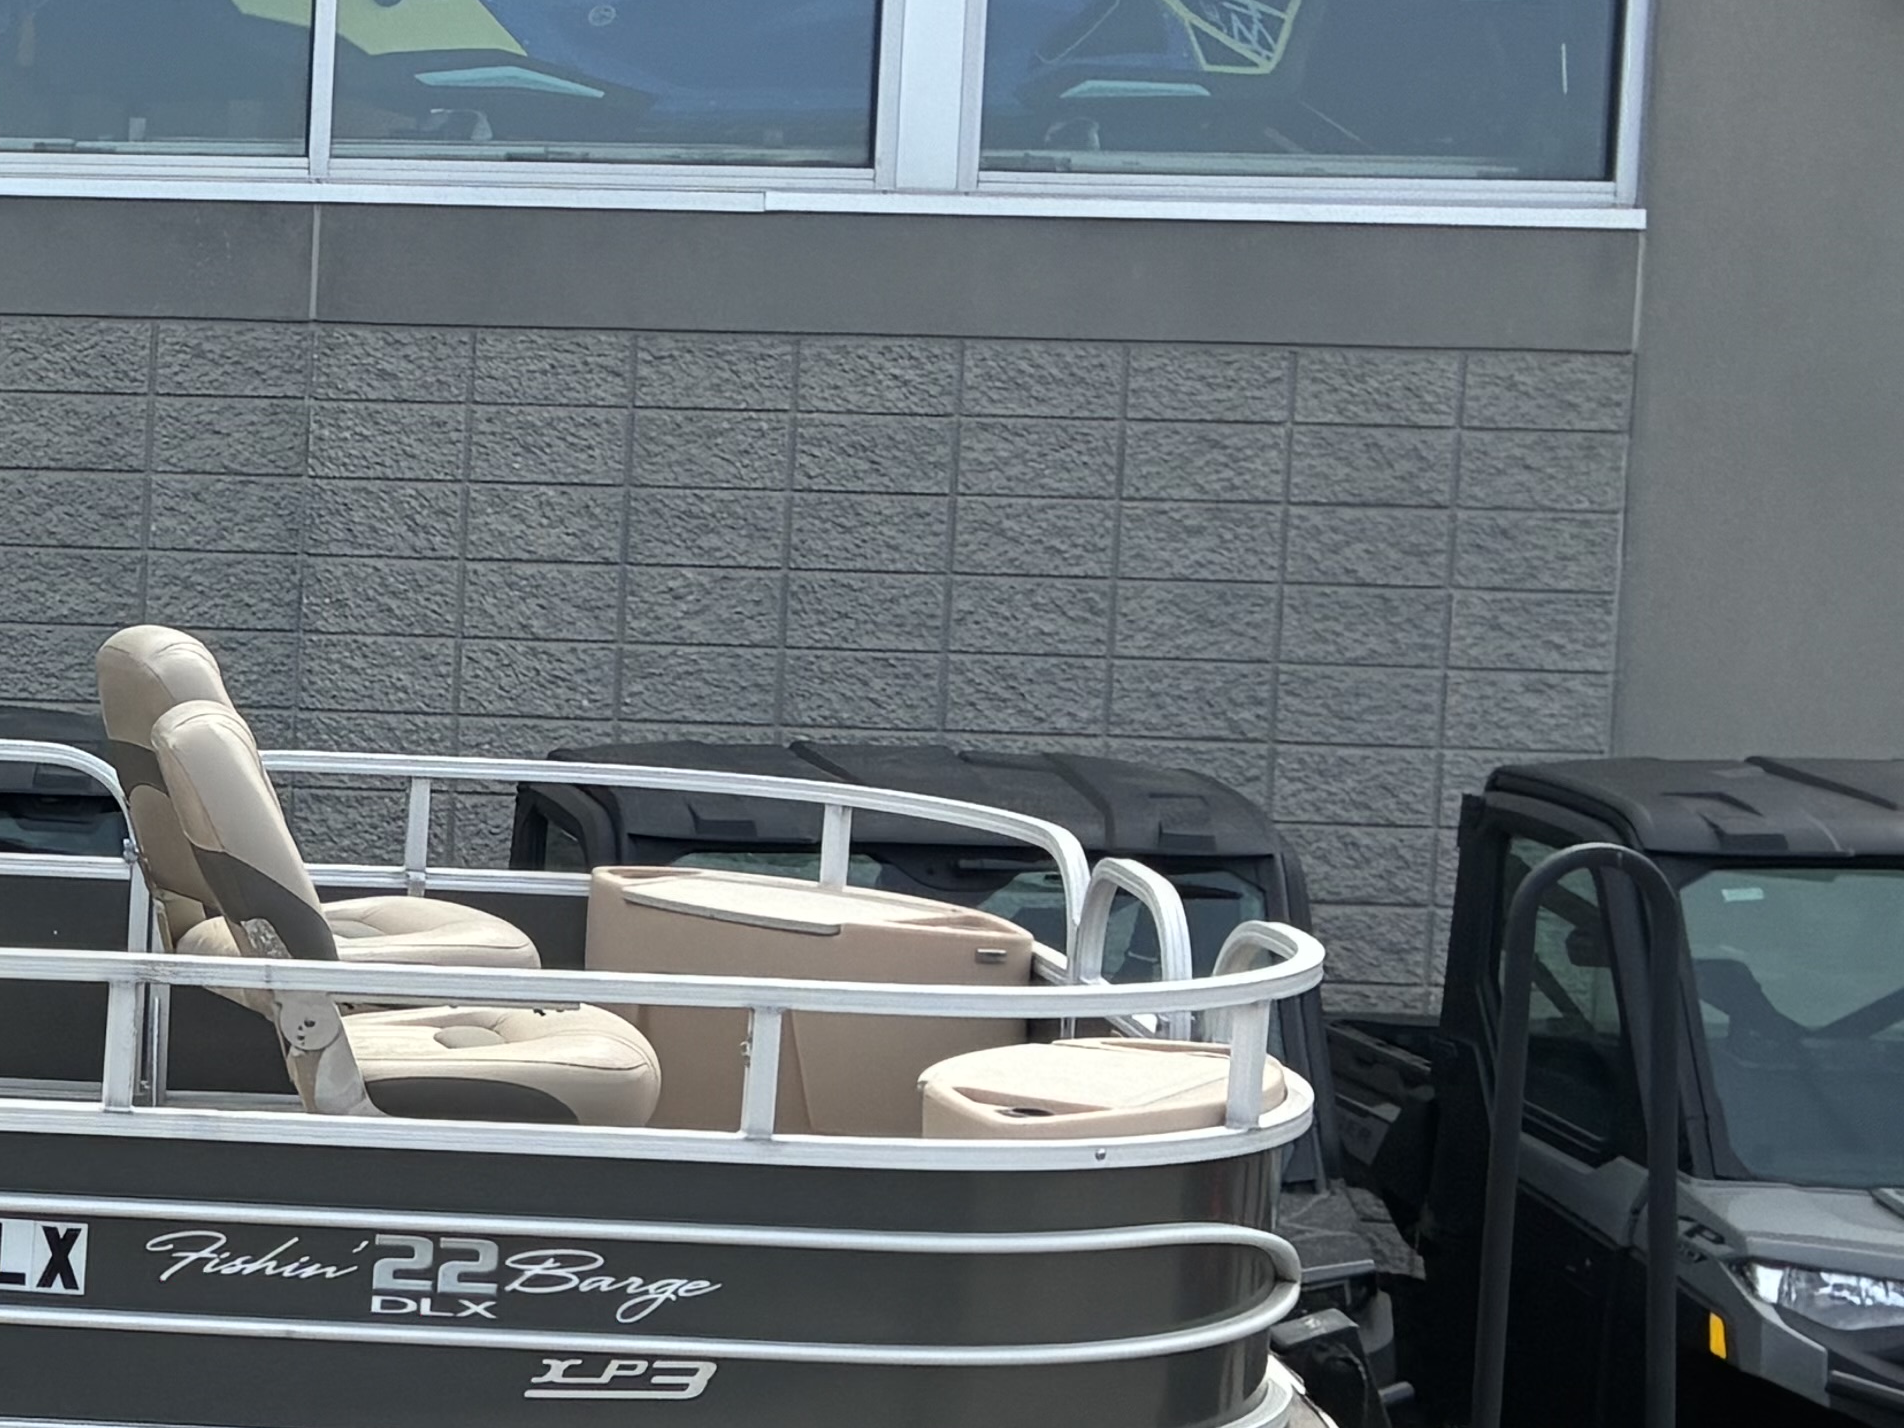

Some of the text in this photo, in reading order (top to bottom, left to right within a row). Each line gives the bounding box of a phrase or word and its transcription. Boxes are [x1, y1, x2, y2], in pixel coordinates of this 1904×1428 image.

[145, 1230, 723, 1323] Fishin' 22 Barge
[370, 1295, 498, 1319] DLX
